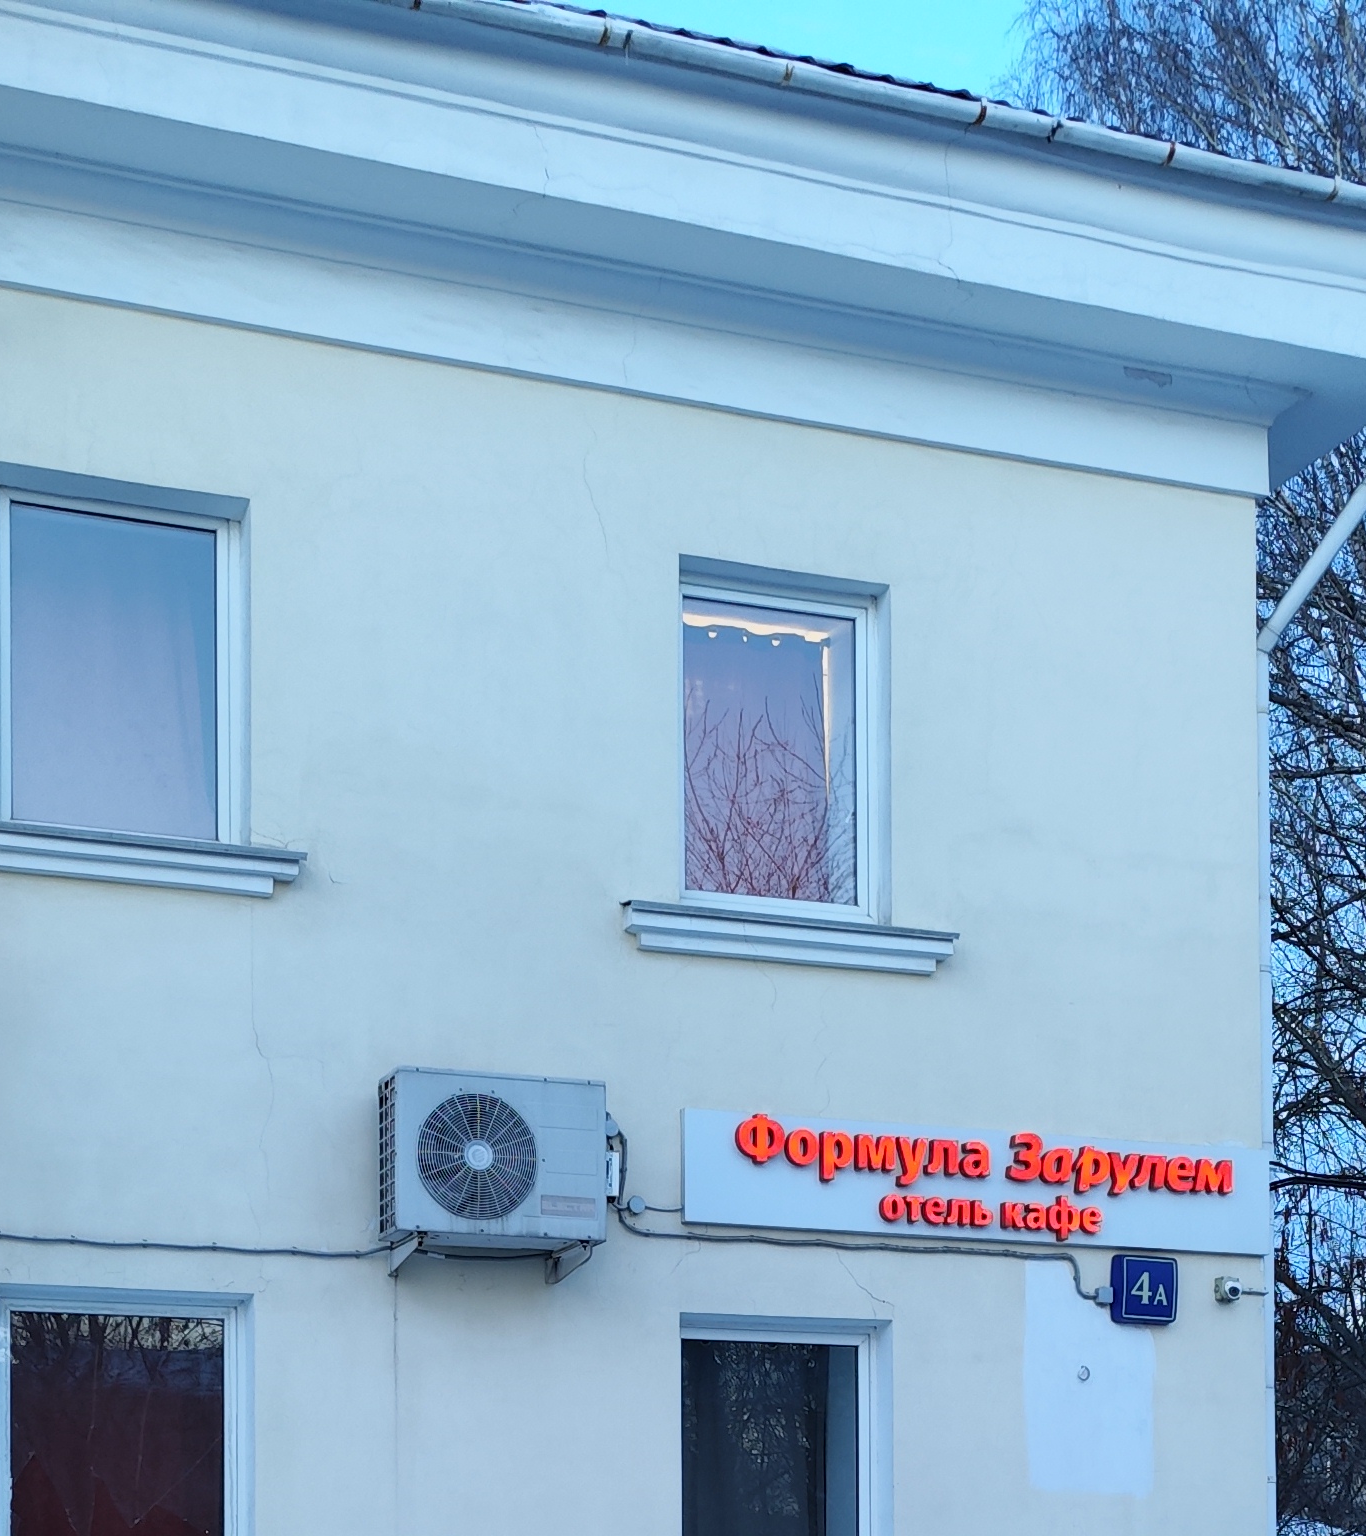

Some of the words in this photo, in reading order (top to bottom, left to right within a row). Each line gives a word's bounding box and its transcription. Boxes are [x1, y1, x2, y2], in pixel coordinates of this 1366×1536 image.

[735, 1113, 990, 1187] Формула
[1005, 1132, 1234, 1196] Зарулем
[878, 1193, 994, 1227] отель
[1000, 1195, 1103, 1242] кафе
